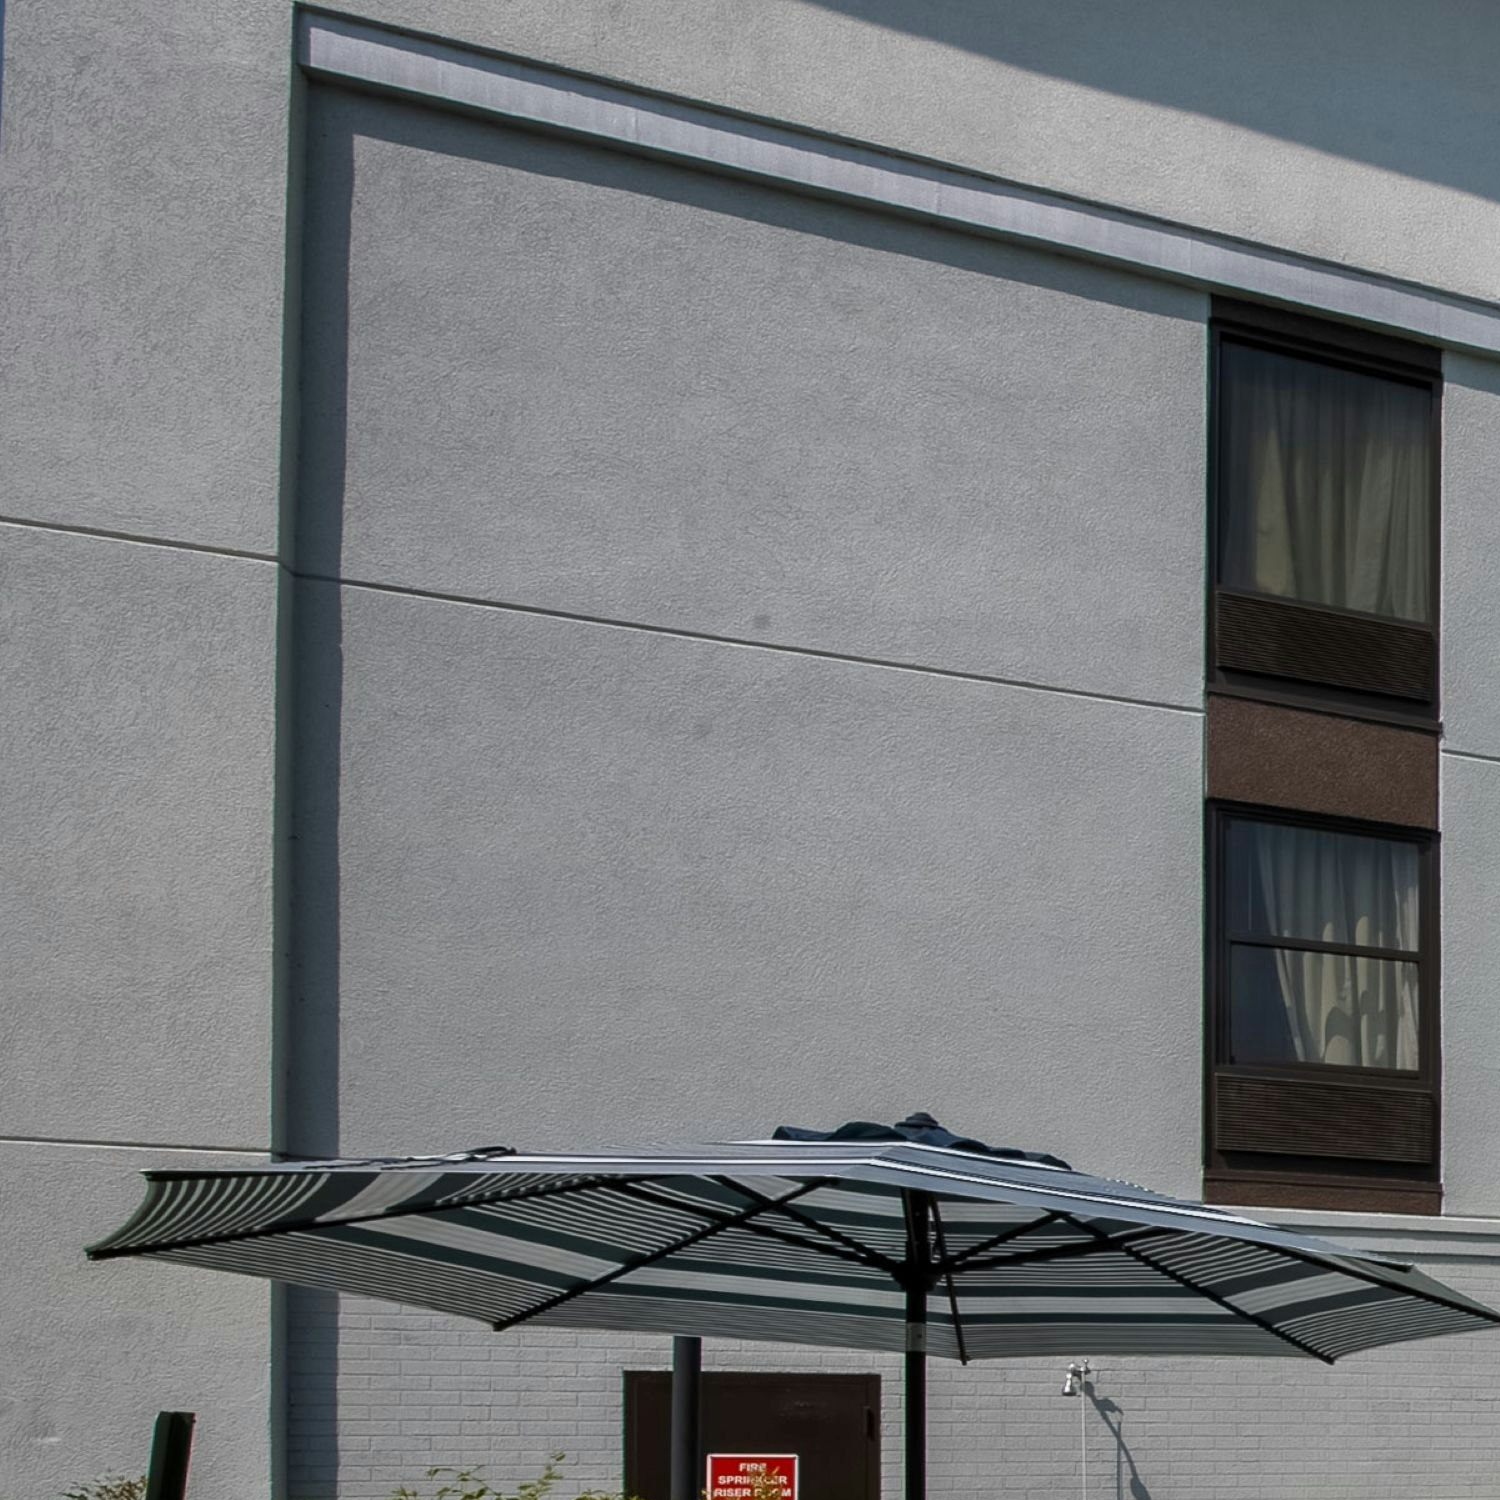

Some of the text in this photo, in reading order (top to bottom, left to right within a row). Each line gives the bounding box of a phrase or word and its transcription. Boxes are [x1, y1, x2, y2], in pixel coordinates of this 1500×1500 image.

[739, 1462, 767, 1472] FIRE
[713, 1488, 792, 1497] RISER RM
